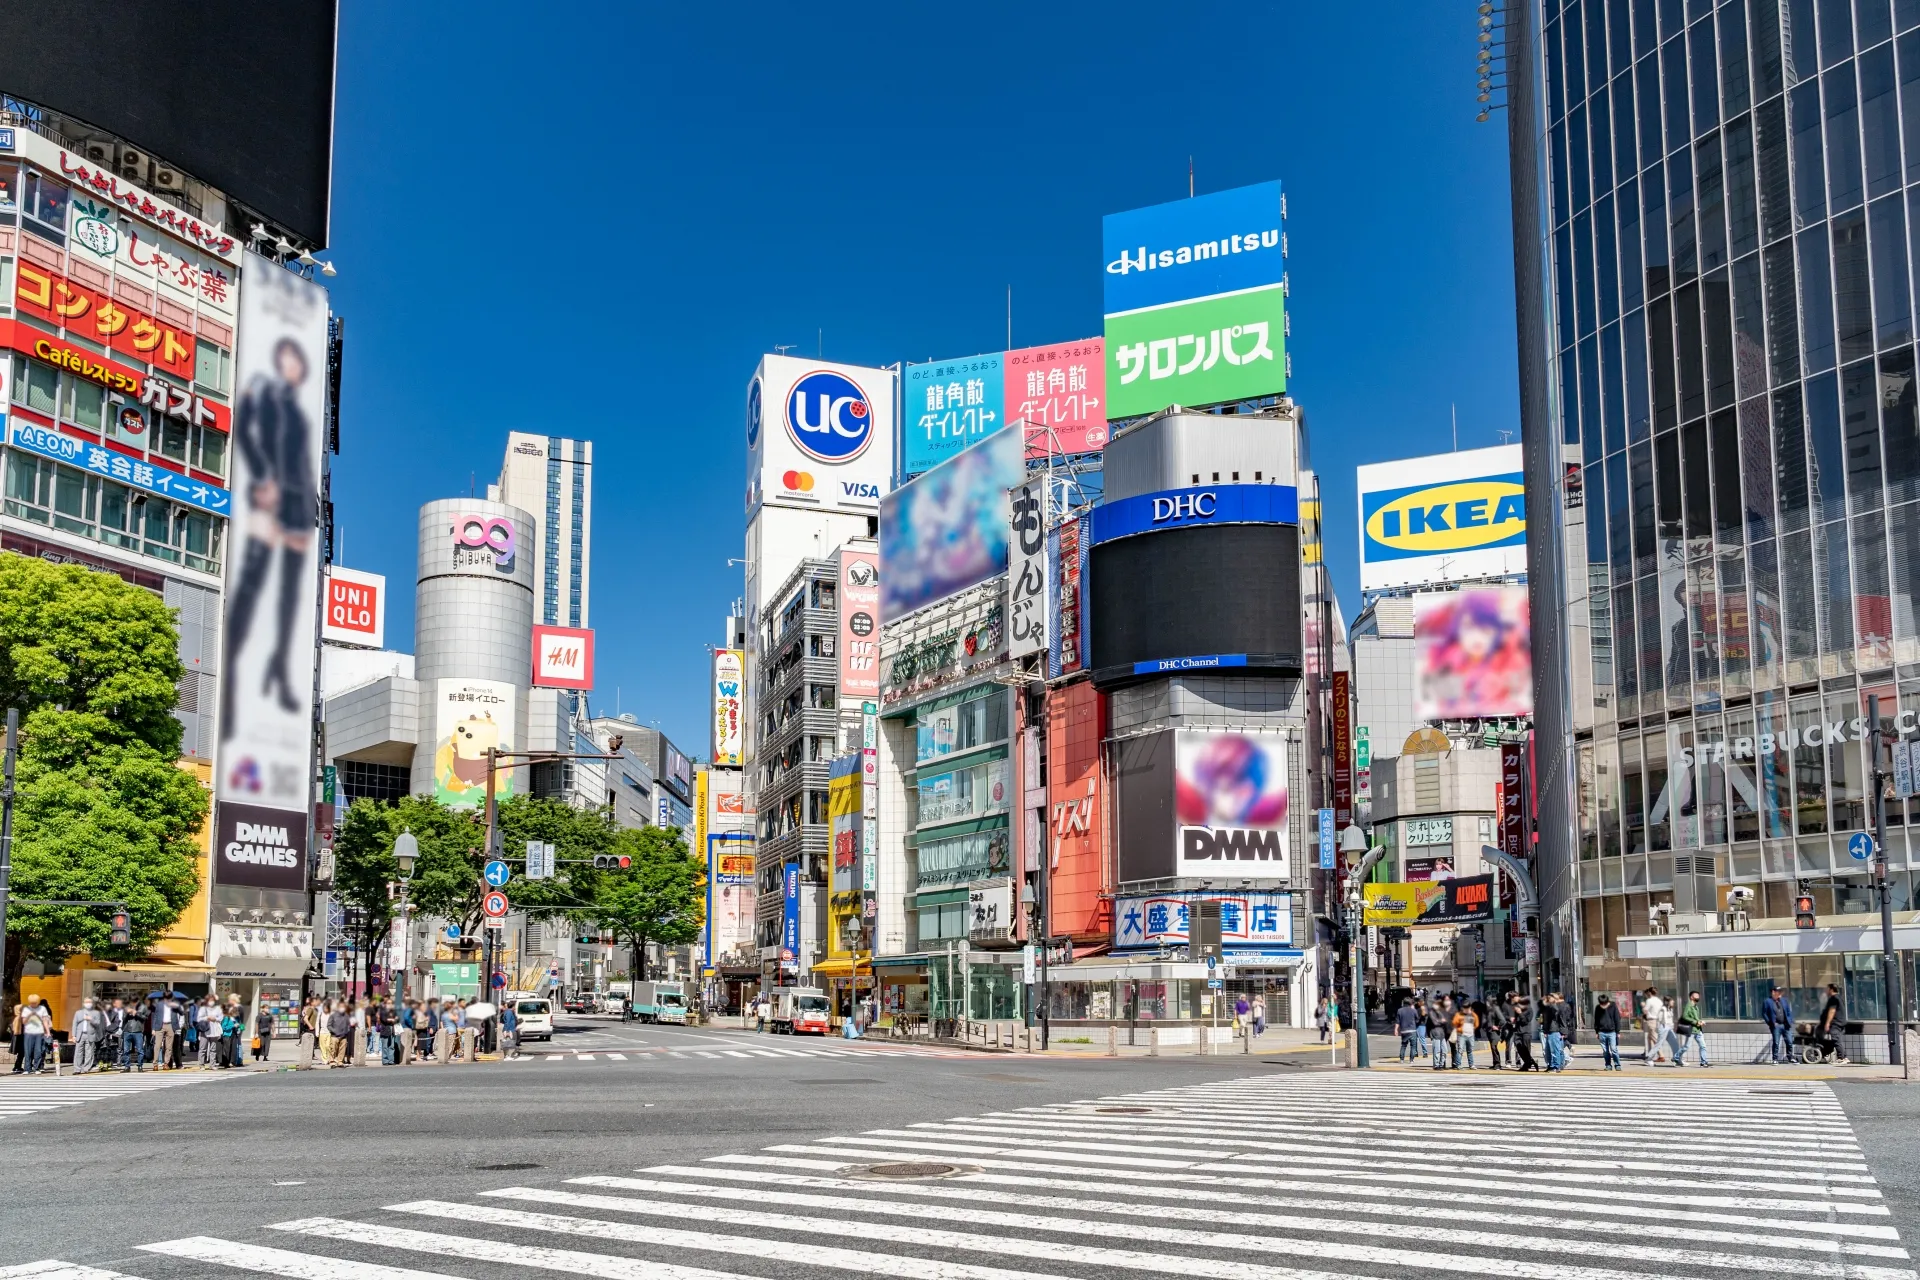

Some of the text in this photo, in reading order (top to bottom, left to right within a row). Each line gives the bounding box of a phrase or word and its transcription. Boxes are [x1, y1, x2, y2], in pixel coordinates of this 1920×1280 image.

[60, 151, 234, 253] しゃぶしゃぶバイキング
[129, 230, 227, 303] しゃぶ葉
[1106, 229, 1278, 275] Hisamitsu
[18, 267, 190, 363] コンタクト
[35, 339, 137, 393] Caféレストラン
[1011, 346, 1101, 365] のど、直接、うるおう
[1115, 321, 1273, 385] サロンパス
[912, 360, 999, 380] のど、直接、うるおう
[1026, 364, 1087, 397] 龍角散
[140, 377, 215, 427] ガスト
[926, 378, 984, 412] 龍角散
[1018, 393, 1099, 427] ダイレクト
[796, 391, 865, 438] UC
[918, 407, 996, 440] ダイレクト
[21, 427, 228, 508] AEON 英会話イーオン
[784, 490, 814, 498] mastercard
[841, 481, 879, 498] VISA
[1152, 492, 1216, 521] DHC
[1382, 493, 1526, 538] IKEA
[451, 513, 515, 565] 109
[452, 550, 492, 570] SHIBUYA
[1012, 486, 1043, 647] もんじゃ
[333, 585, 368, 607] UNI
[333, 605, 371, 627] QLO
[547, 646, 579, 668] H&M
[1159, 657, 1219, 669] DHC Channel
[448, 691, 506, 704] 新登場イエロー
[1335, 675, 1350, 823] クスリのことなら 三千里
[1680, 717, 1870, 768] STARBUCKS
[1504, 754, 1521, 826] カラオケ
[236, 822, 289, 847] DMM
[697, 791, 706, 859] Matsumoto KiYoshi
[1052, 777, 1096, 868] クスリ
[1322, 812, 1332, 866] 大盛堂商事ビル
[1408, 832, 1453, 843] クリニック
[1418, 820, 1452, 831] れいわ
[225, 842, 297, 868] GAMES
[1183, 829, 1283, 861] DMM
[789, 870, 798, 899] MIZUHO
[918, 867, 986, 885] ジャスミンレディースクリニック
[1456, 884, 1488, 905] ALVARK
[393, 922, 401, 965] 道玄坂
